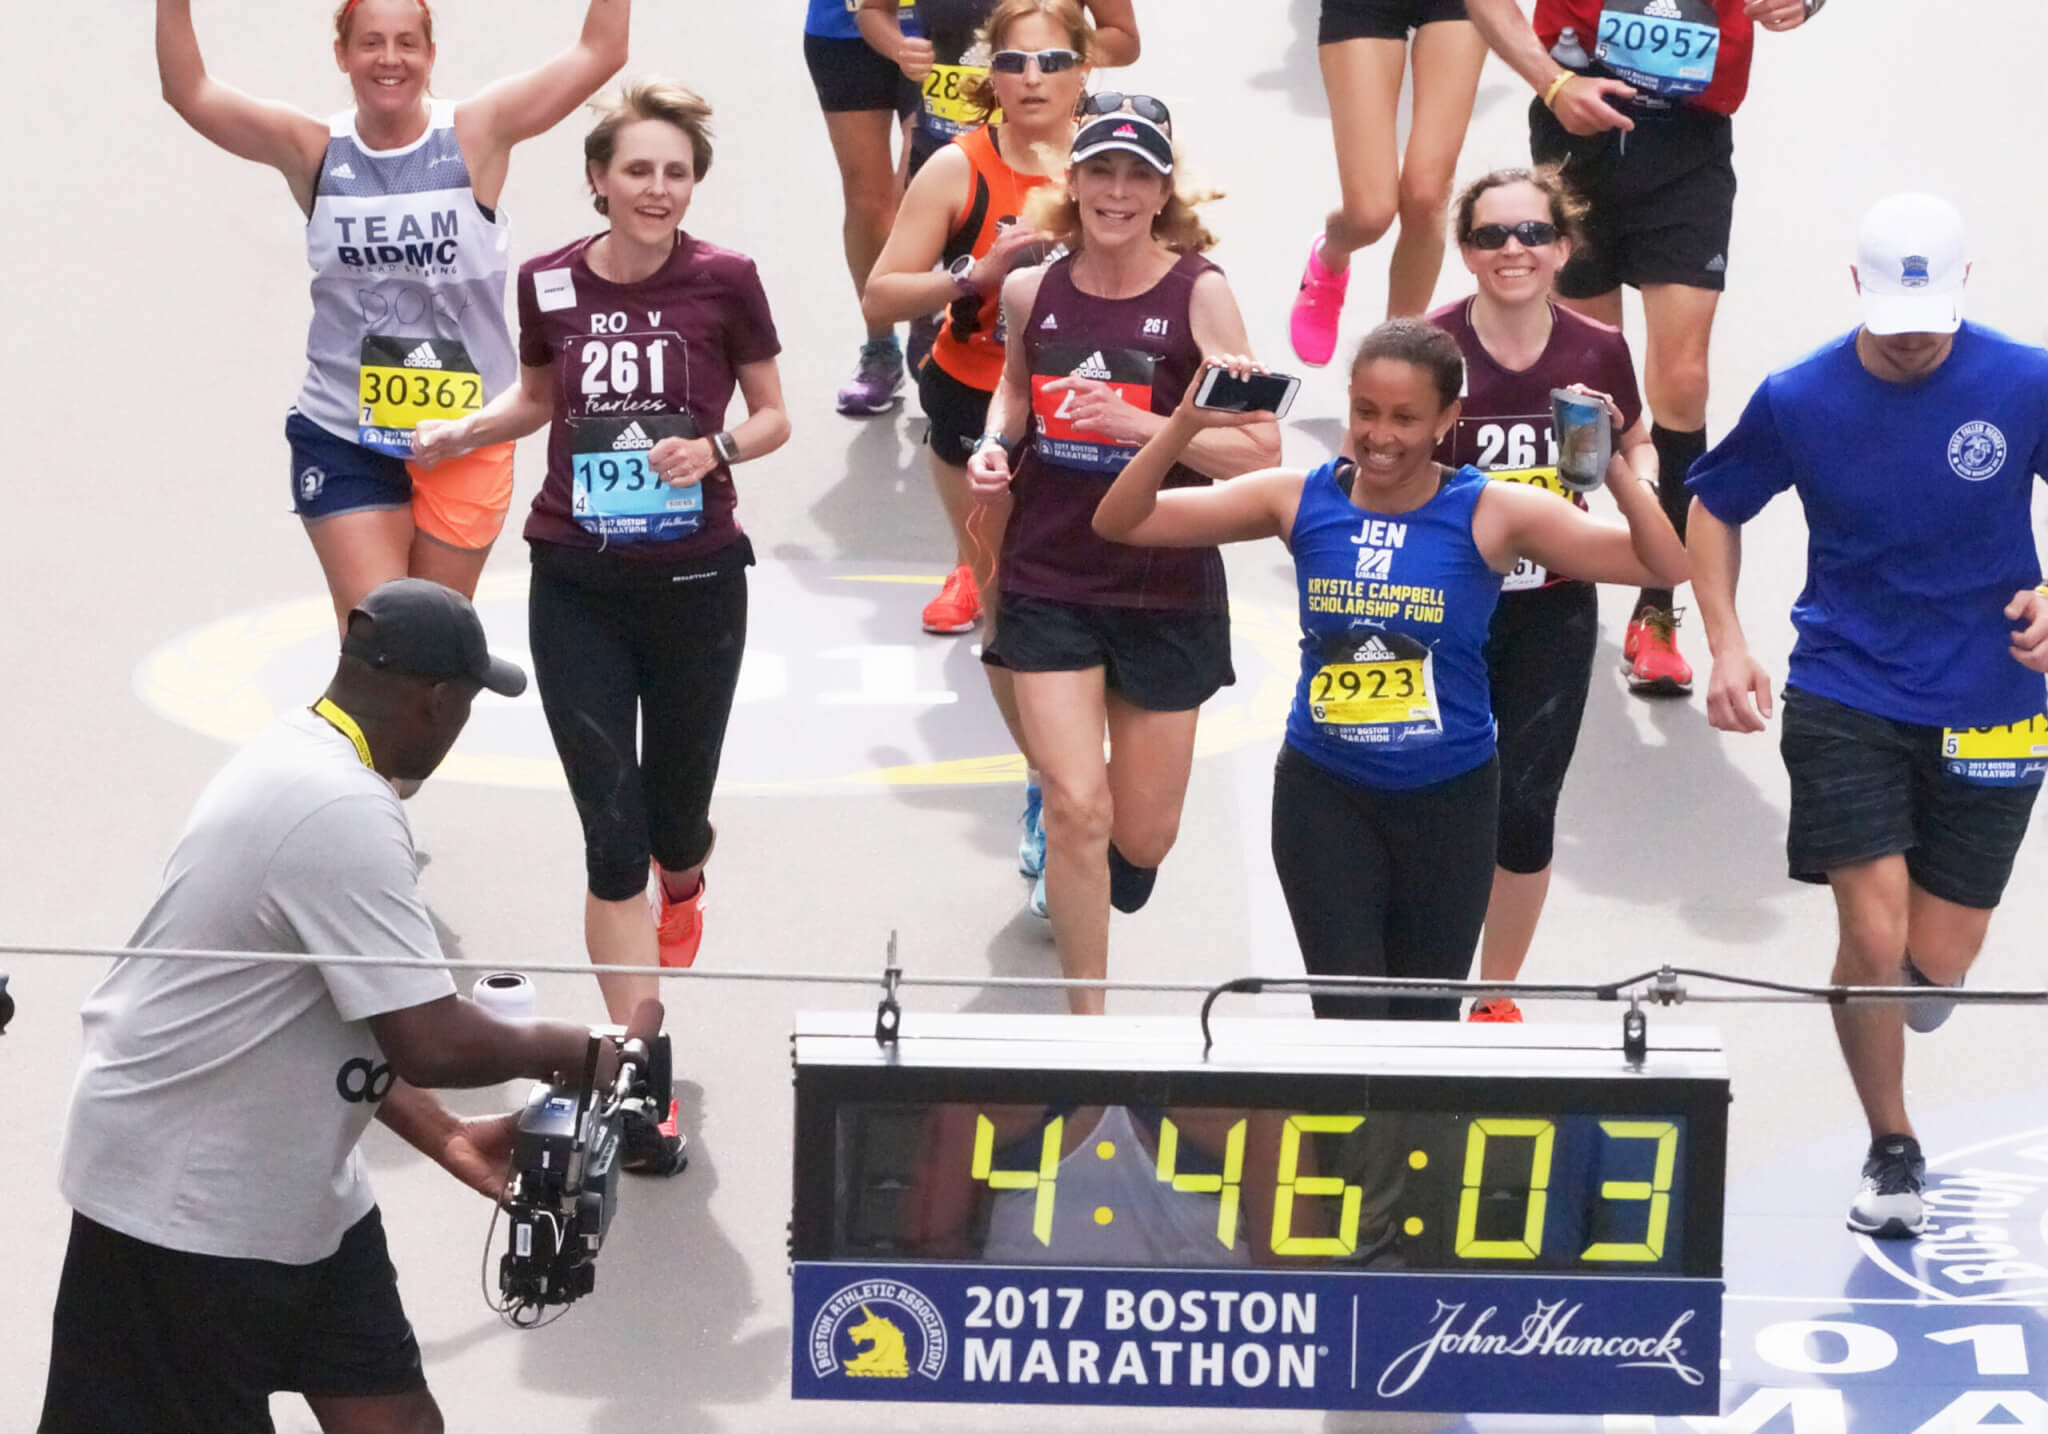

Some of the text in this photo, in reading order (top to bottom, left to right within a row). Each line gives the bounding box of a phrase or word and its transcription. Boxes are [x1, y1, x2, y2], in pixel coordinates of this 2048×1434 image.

[1601, 18, 1717, 59] 20957
[334, 210, 458, 243] TEAM
[337, 240, 458, 267] BIDMC
[590, 311, 662, 334] RO V
[1143, 318, 1168, 335] 261
[403, 357, 442, 369] adidas
[581, 339, 665, 394] 261
[363, 373, 480, 409] 30362
[584, 394, 667, 415] Fearless
[362, 407, 372, 422] 7
[612, 439, 654, 450] adidas
[579, 458, 662, 493] 193
[575, 497, 586, 513] 4
[1350, 520, 1407, 548] JEN
[1308, 578, 1445, 606] KRYSTLE CAMPBELL
[1308, 596, 1400, 618] SCHOLARSHIP
[1404, 605, 1445, 624] FUND
[1317, 667, 1426, 703] 2923
[1314, 705, 1326, 719] 6
[1946, 738, 1957, 754] 5
[971, 1113, 1679, 1262] 4:46:03
[965, 1286, 1316, 1334] 2017 BOSTON
[815, 1284, 942, 1372] BOSTON ATHLETIC ASSOCIATION
[963, 1337, 1316, 1388] MARATHON
